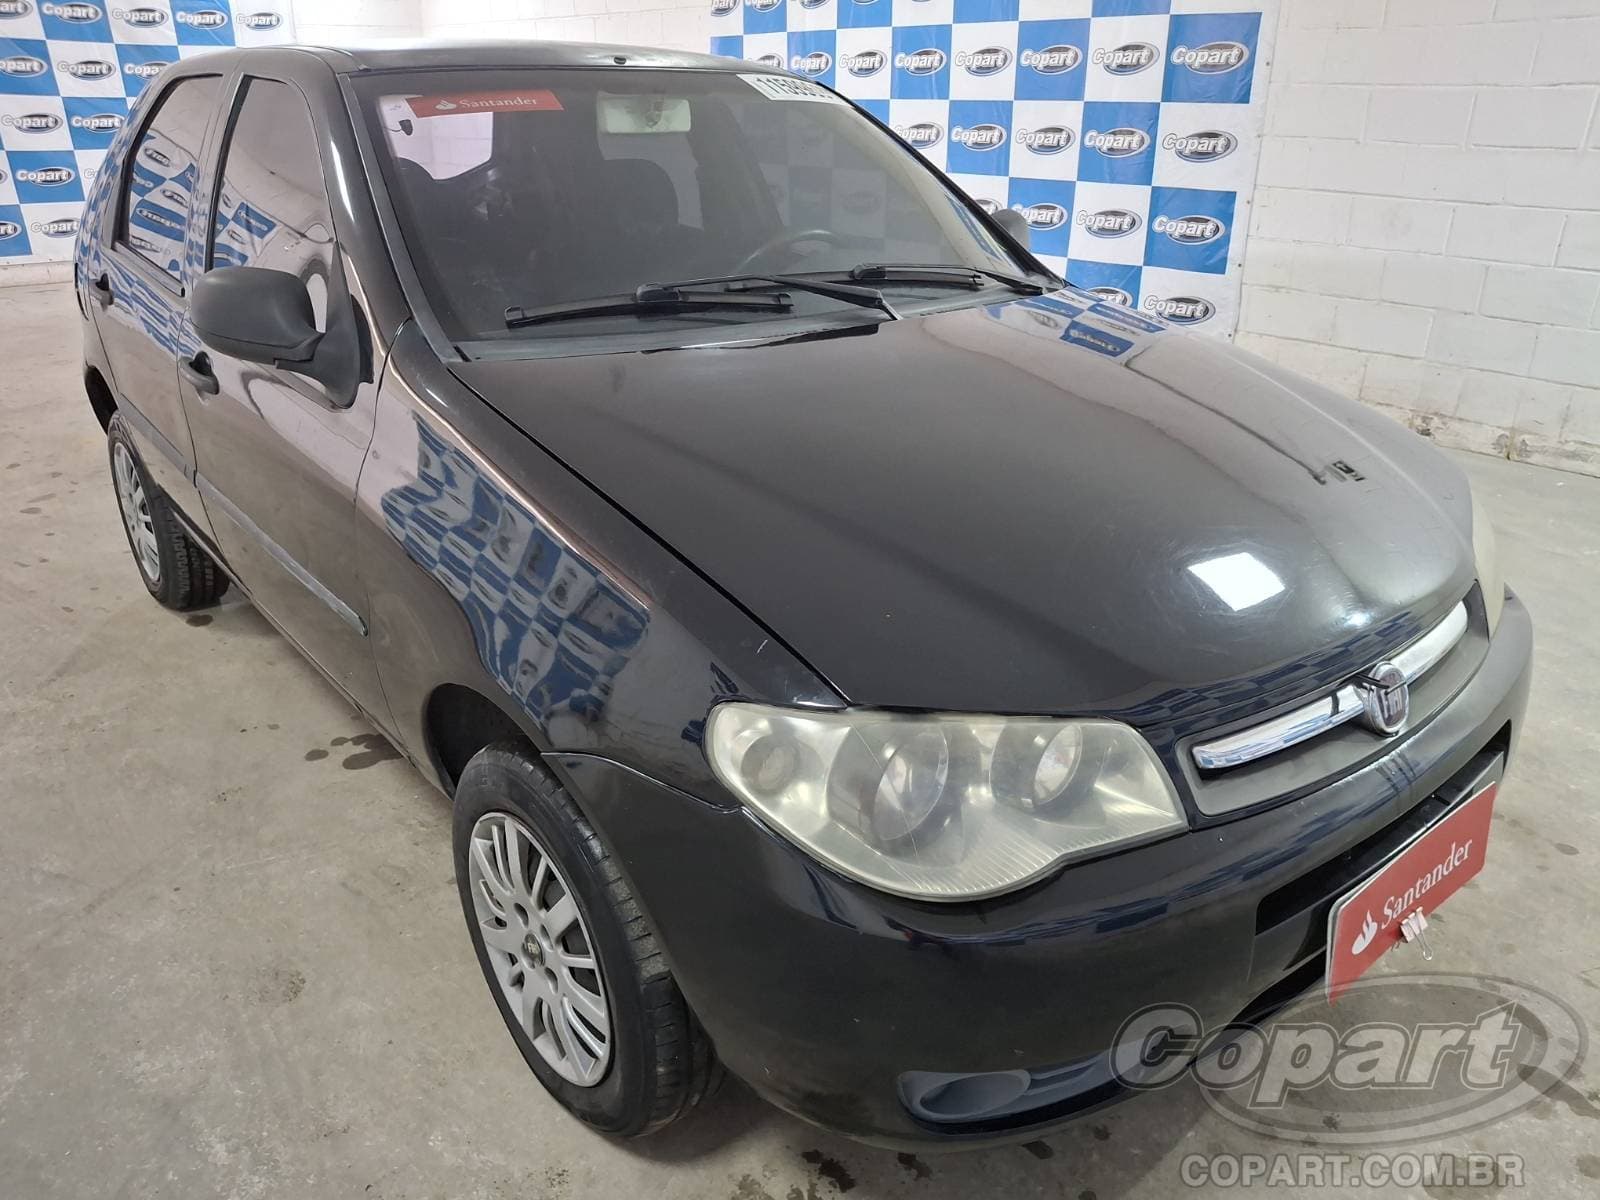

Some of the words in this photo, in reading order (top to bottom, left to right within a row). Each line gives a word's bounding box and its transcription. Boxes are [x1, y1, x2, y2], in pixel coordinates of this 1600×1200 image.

[0, 0, 24, 12] art
[42, 3, 96, 19] Copart
[112, 8, 160, 22] Copart
[176, 11, 221, 26] Copart
[236, 13, 277, 26] Copart
[0, 60, 40, 72] opart
[791, 55, 826, 73] Copart
[839, 54, 881, 71] Copart
[895, 52, 940, 71] Copart
[955, 51, 1005, 70] Copart
[1021, 48, 1075, 70] Copart
[1092, 48, 1150, 69] Copart
[1171, 45, 1239, 69] Copart
[57, 61, 108, 76] Copart
[124, 63, 160, 77] Copa
[459, 97, 537, 109] Santander
[2, 114, 56, 129] Copart
[71, 115, 120, 129] Copart
[951, 126, 1001, 148] Copart
[1016, 128, 1069, 149] Copart
[1084, 130, 1143, 153] Copart
[1161, 133, 1226, 155] Copart
[16, 170, 69, 183] Copart
[1076, 209, 1132, 232] Copart
[1152, 215, 1217, 238] Copart
[1144, 295, 1204, 318] Copart
[1381, 839, 1472, 929] Santander
